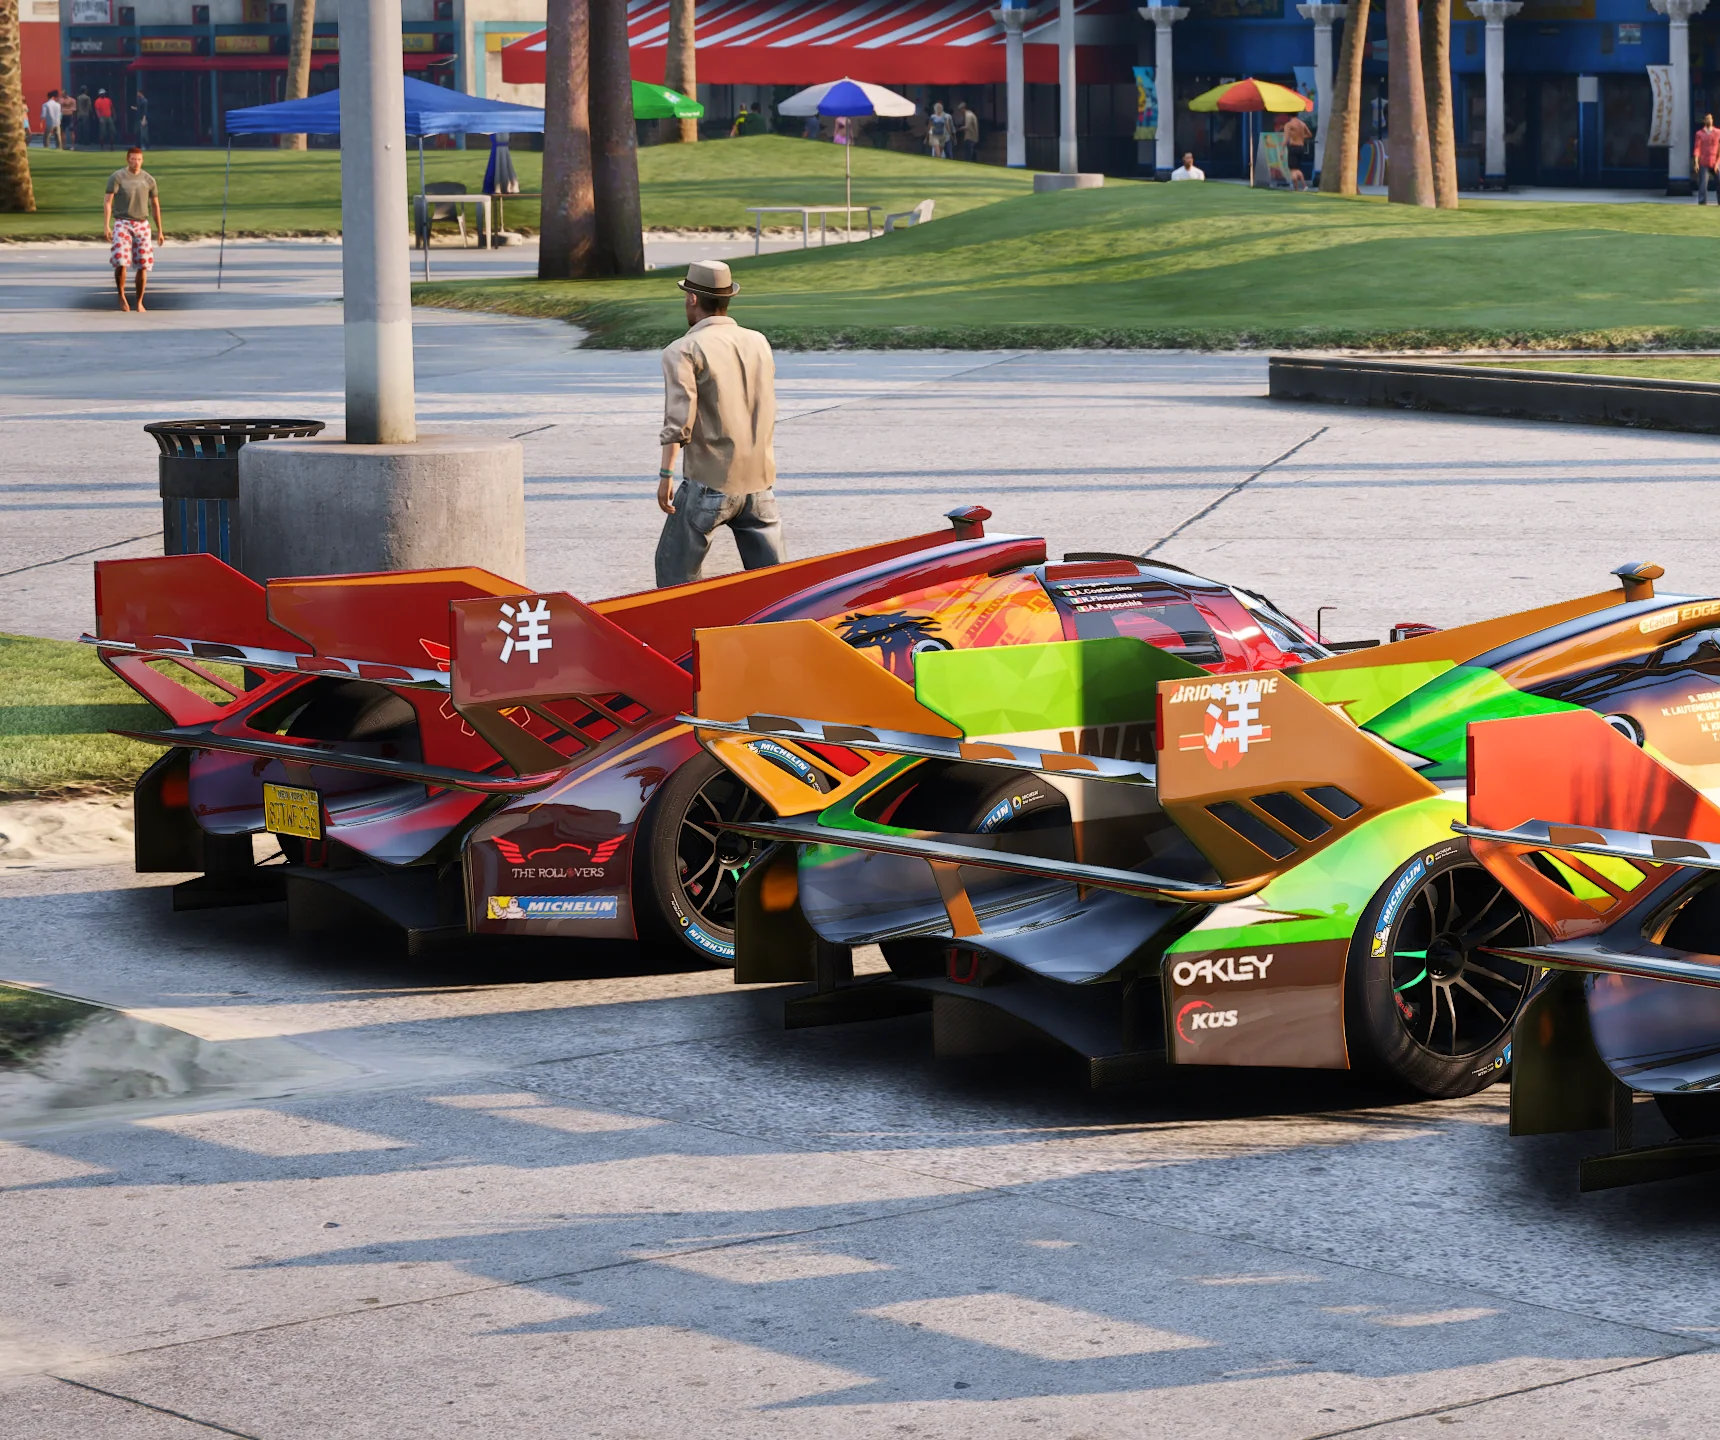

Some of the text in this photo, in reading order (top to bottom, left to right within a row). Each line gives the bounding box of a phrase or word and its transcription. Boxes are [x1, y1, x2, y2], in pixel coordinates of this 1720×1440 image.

[1681, 602, 1720, 622] EDGE
[497, 599, 552, 664] 洋
[1206, 678, 1263, 754] 洋
[760, 742, 808, 772] MICHELIN
[512, 868, 536, 879] THE
[527, 901, 614, 912] MICHELIN
[1382, 862, 1422, 924] MICHELIN
[689, 928, 735, 956] MICHELIN
[1173, 954, 1274, 987] OAKLEY
